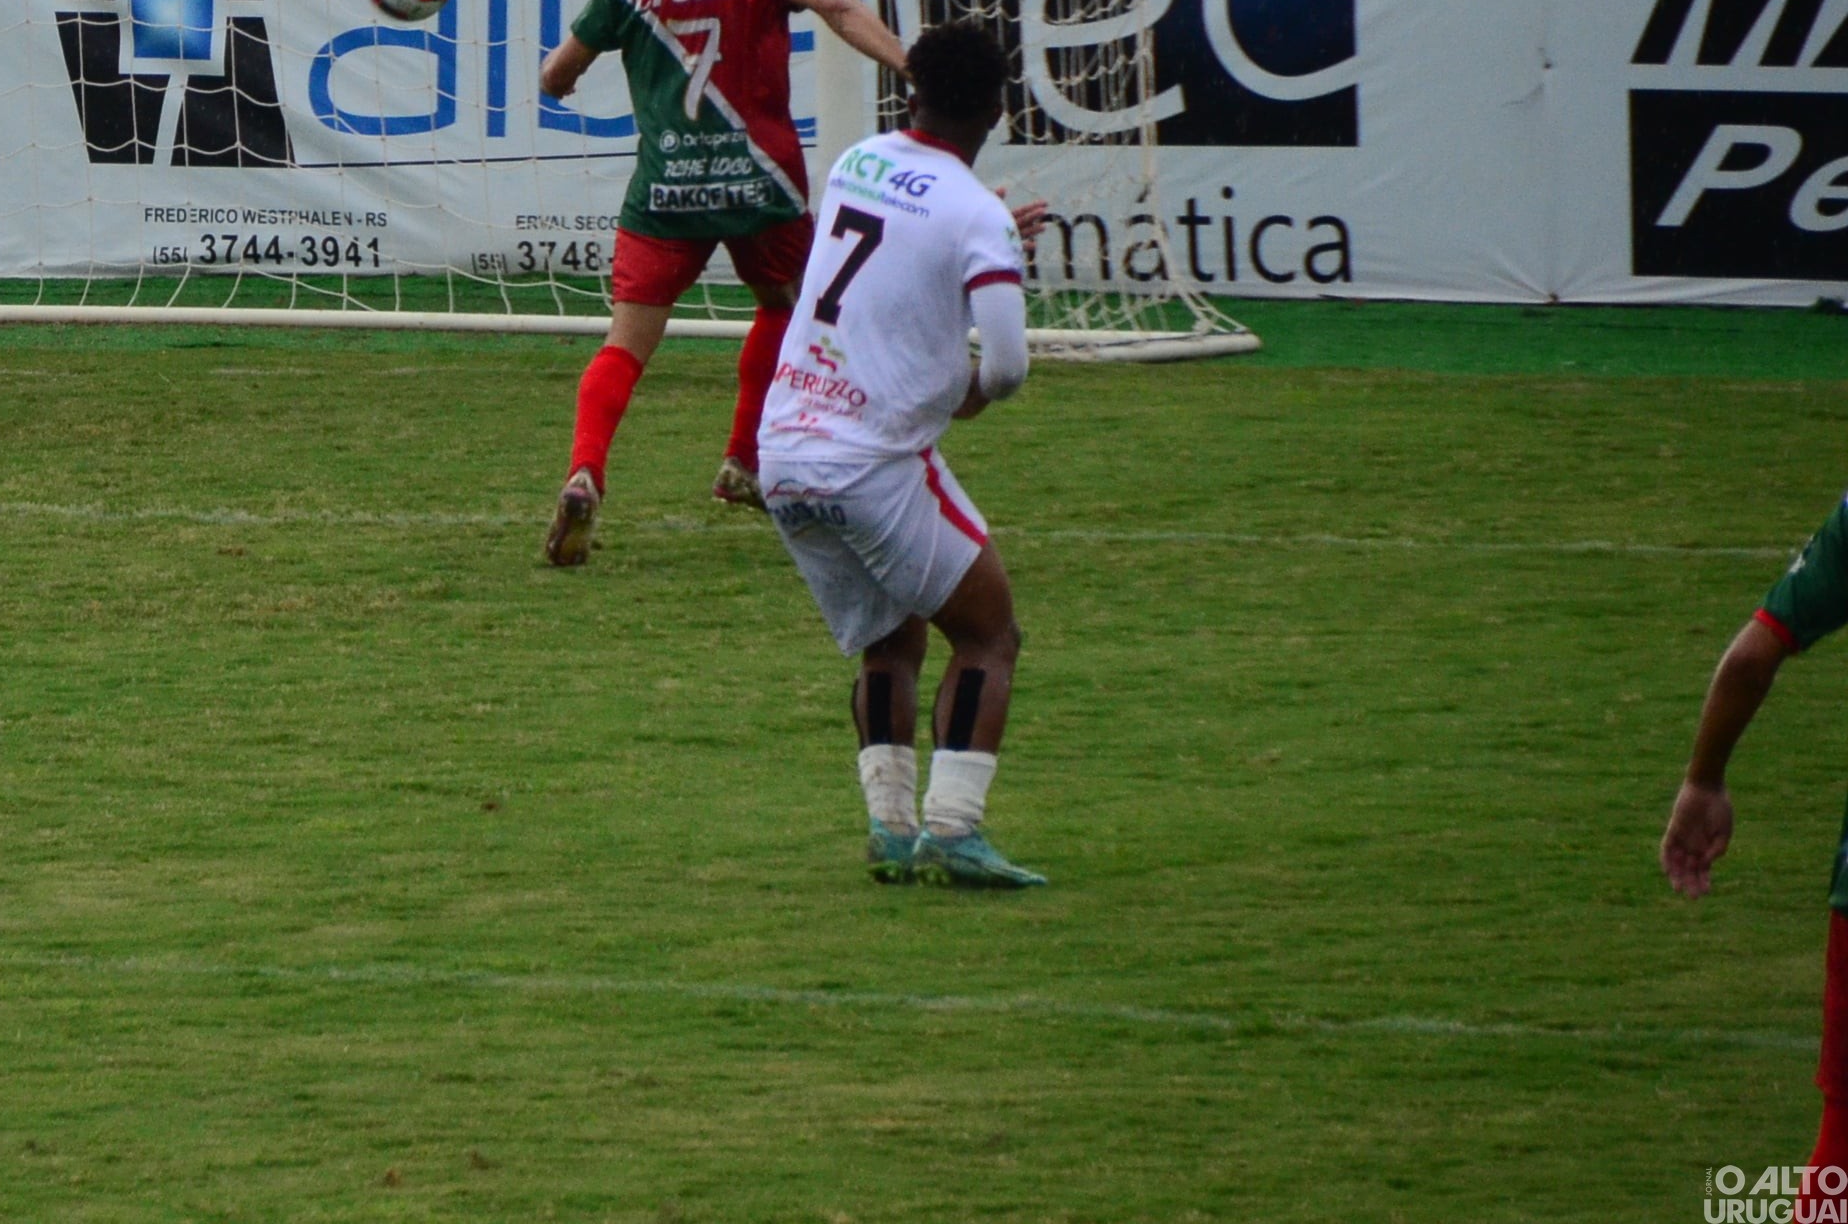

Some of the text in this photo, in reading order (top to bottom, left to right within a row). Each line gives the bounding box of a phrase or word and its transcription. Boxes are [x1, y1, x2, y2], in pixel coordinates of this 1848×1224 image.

[666, 16, 723, 122] 7
[652, 185, 725, 209] BAKOF
[887, 169, 938, 198] 4G
[144, 207, 238, 225] FREDERICO
[242, 208, 352, 226] WESTPHALEN
[365, 212, 388, 228] RS
[199, 233, 380, 268] 3744-3941
[812, 203, 886, 327] 7
[773, 361, 868, 408] PERUZZO
